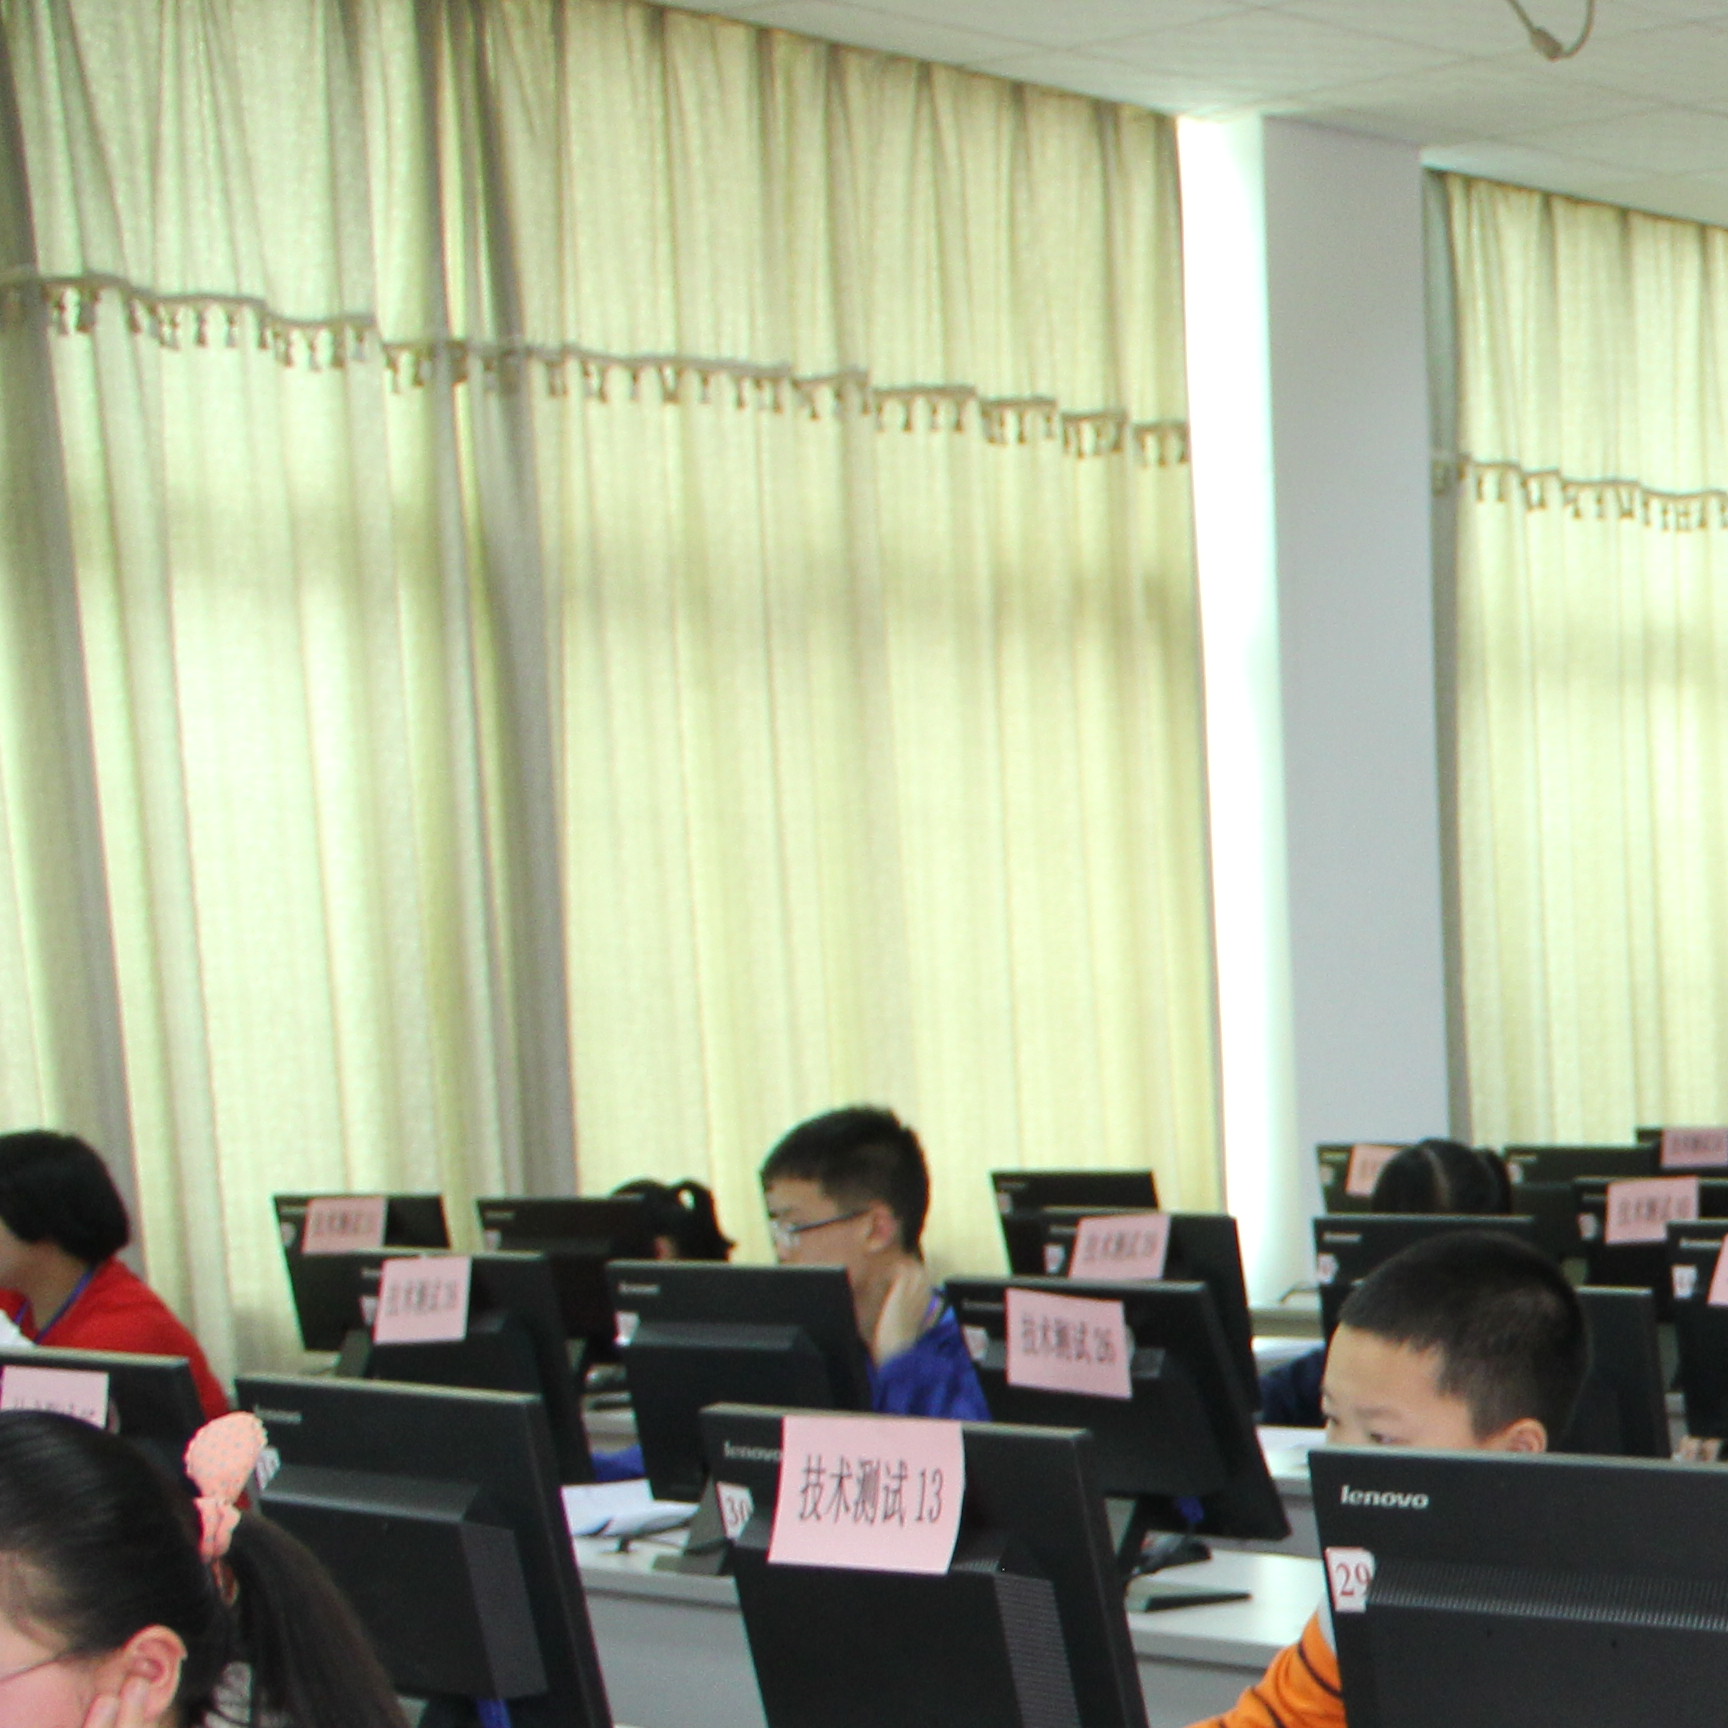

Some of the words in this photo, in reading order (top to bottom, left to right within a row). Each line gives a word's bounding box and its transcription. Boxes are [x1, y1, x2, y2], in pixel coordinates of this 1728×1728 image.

[799, 1453, 945, 1530] 技术测试13
[1341, 1485, 1430, 1510] lenovo
[1335, 1562, 1374, 1597] 29
